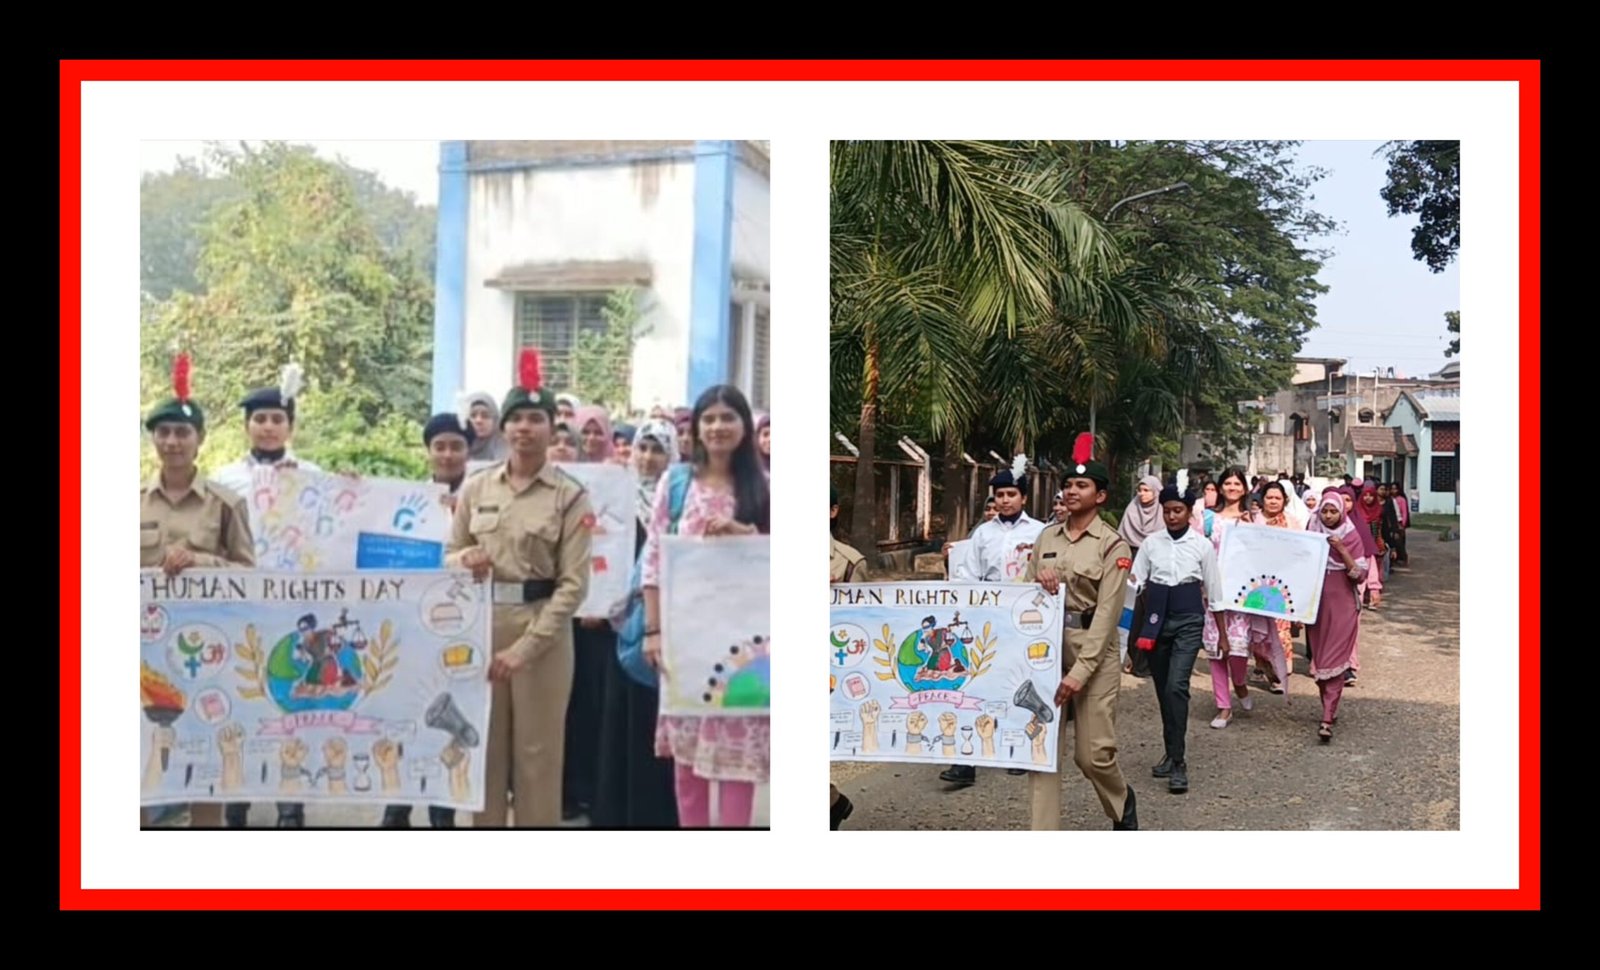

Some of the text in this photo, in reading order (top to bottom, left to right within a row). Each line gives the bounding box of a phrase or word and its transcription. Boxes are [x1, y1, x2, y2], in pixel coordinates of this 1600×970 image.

[151, 576, 405, 600] HUMAN RIGHTS DAY
[895, 588, 958, 605] RIGHTS
[969, 589, 1002, 606] DAY
[917, 692, 948, 702] PEACE
